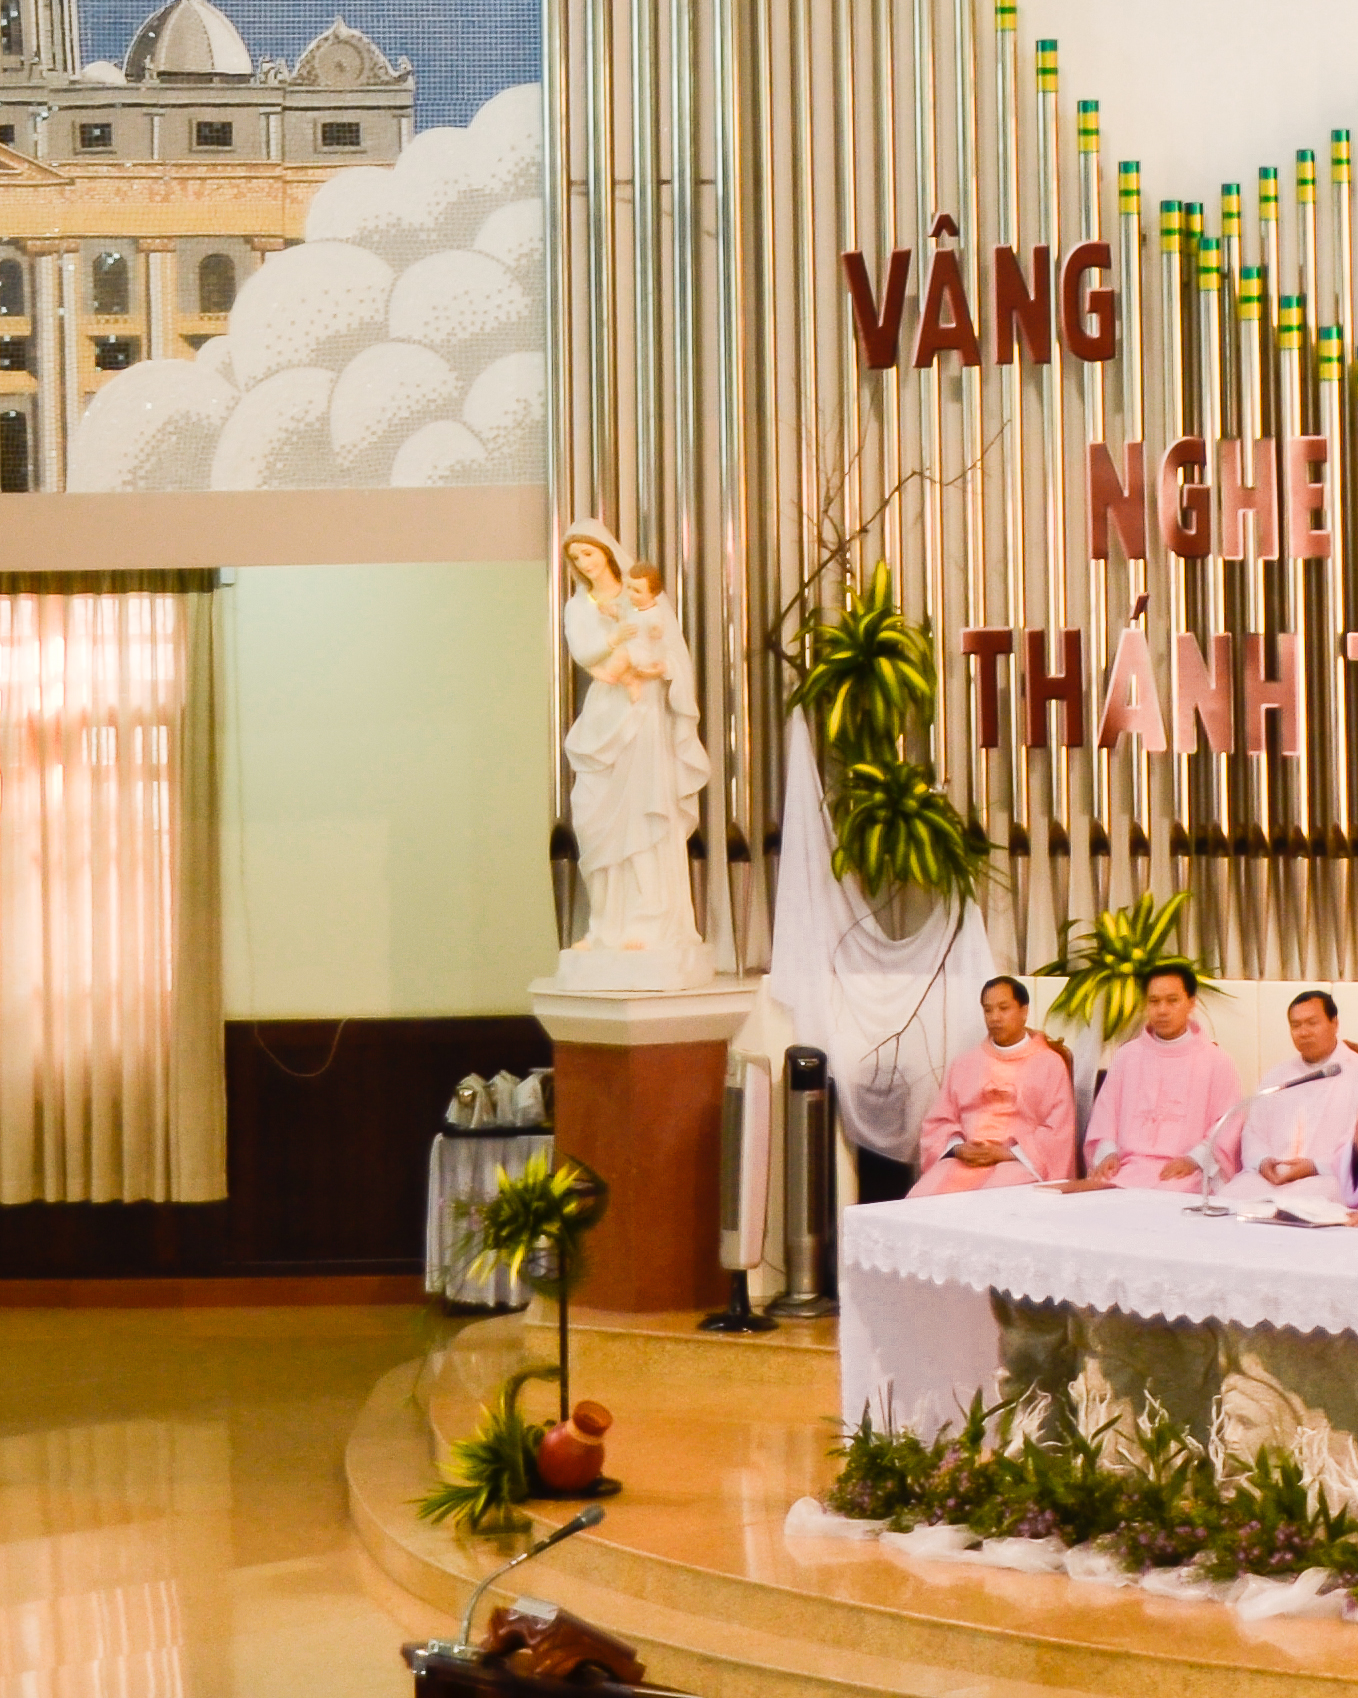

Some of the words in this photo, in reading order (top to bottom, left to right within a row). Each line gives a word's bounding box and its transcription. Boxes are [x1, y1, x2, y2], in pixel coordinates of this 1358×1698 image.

[842, 213, 1116, 369] VÂNG
[1088, 436, 1331, 560] NGHE
[963, 593, 1299, 755] THÁNH
